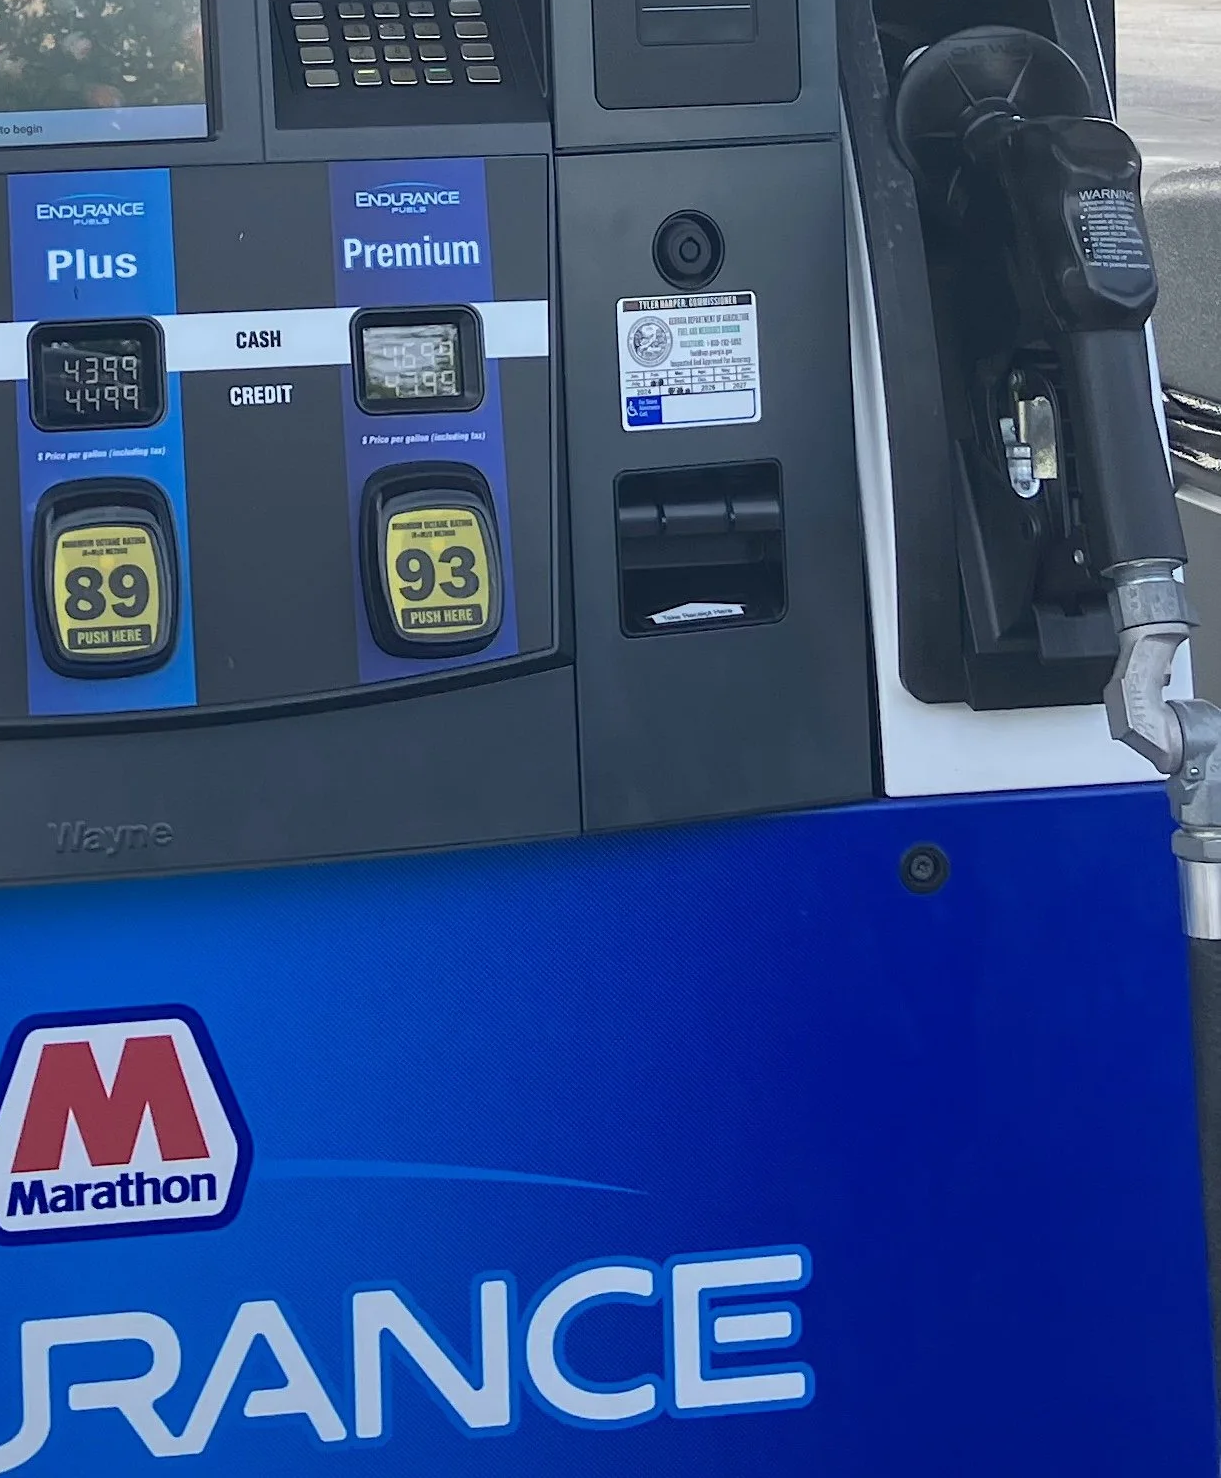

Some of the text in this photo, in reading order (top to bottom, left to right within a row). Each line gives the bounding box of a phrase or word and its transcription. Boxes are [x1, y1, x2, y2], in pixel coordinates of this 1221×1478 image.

[0, 125, 10, 135] to
[13, 123, 43, 136] begin
[355, 190, 460, 207] ENDURANCE
[1079, 189, 1135, 202] WARNING
[36, 202, 145, 220] ENDURANCE
[391, 206, 427, 214] FUELS
[73, 218, 110, 226] FUELS
[343, 235, 480, 269] Premium
[47, 248, 138, 281] Plus
[639, 300, 659, 310] TYLER
[689, 295, 737, 307] COMMISSIONER
[236, 330, 282, 349] CASH
[230, 384, 293, 406] CREDIT
[369, 435, 390, 445] Price
[391, 436, 405, 445] per
[405, 433, 429, 444] gallon
[431, 432, 470, 443] (including
[471, 431, 486, 441] tax)
[45, 452, 65, 461] Price
[67, 452, 81, 462] per
[82, 449, 108, 461] gallon
[108, 447, 148, 460] (including
[150, 446, 166, 457] tax)
[395, 545, 480, 601] 93
[64, 564, 150, 621] 89
[410, 608, 473, 625] PUSH HERE
[682, 610, 712, 620] Receipt
[713, 608, 733, 617] Here
[77, 628, 142, 645] PUSH HERE
[46, 820, 174, 856] Wayne
[6, 1172, 217, 1217] Marathon
